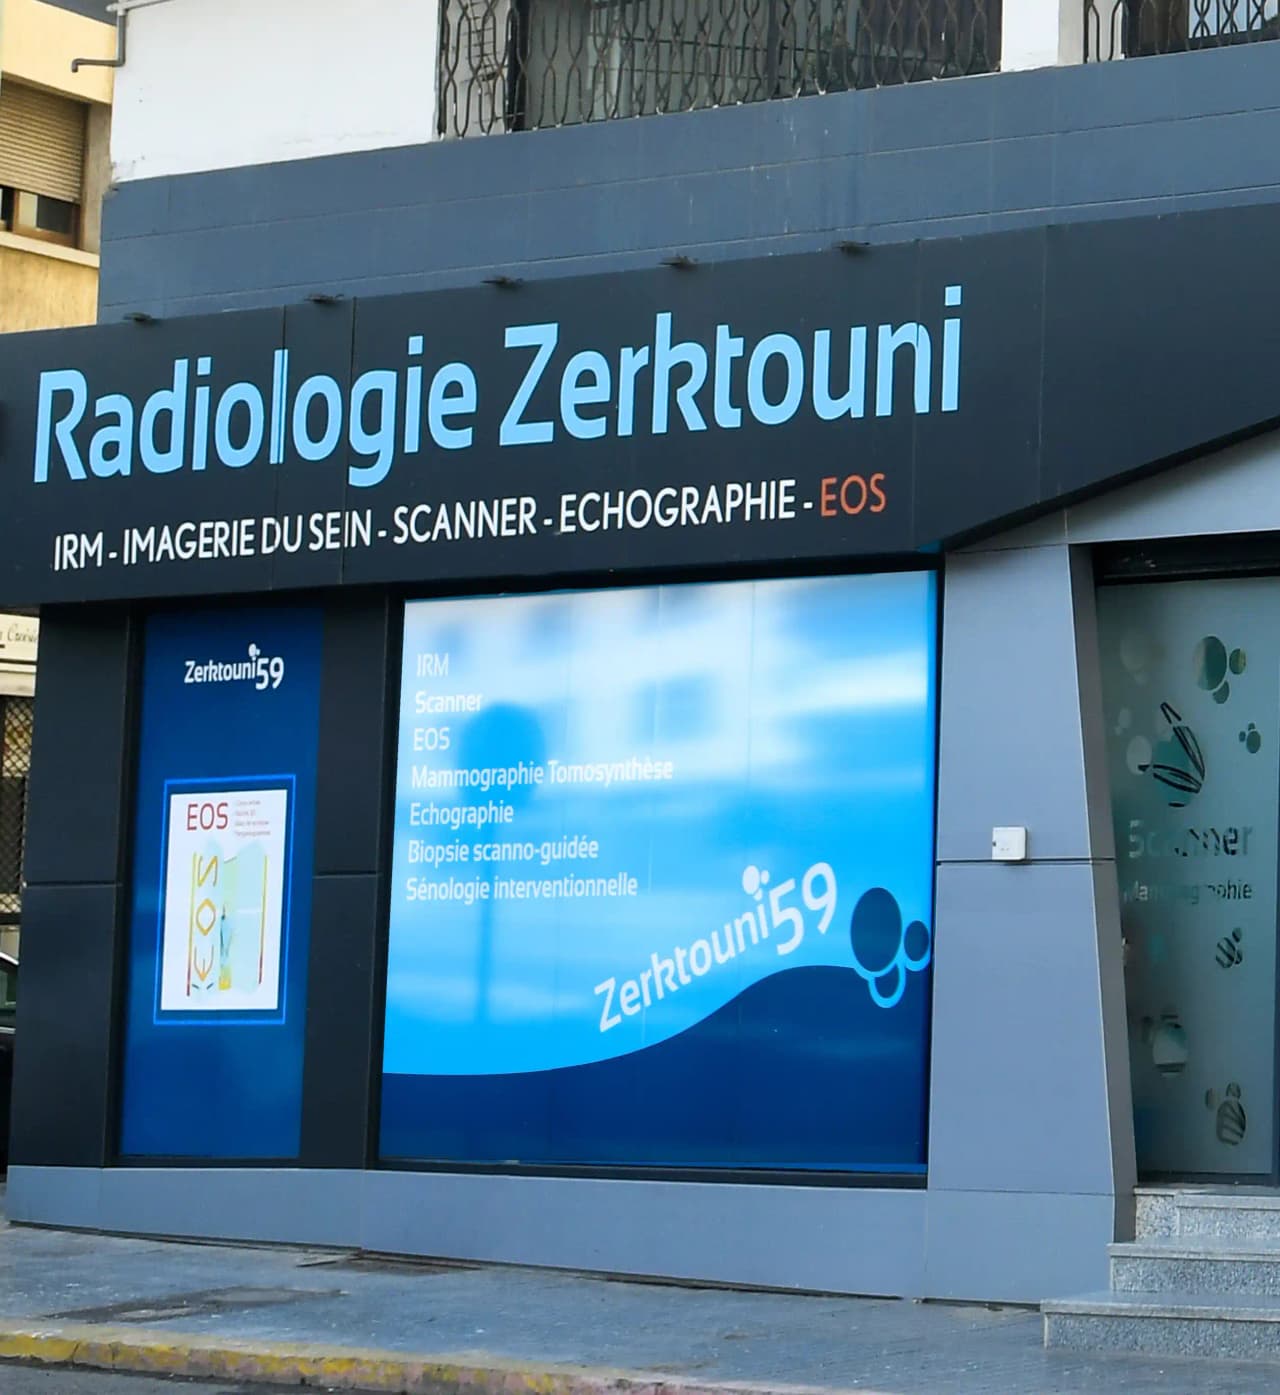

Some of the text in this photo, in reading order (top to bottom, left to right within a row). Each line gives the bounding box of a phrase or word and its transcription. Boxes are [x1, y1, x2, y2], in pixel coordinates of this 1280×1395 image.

[34, 285, 963, 486] Radiologie Zerktouni
[53, 533, 104, 571] IRM
[123, 517, 255, 566] IMAGERIE
[261, 517, 303, 556] DU
[309, 509, 372, 552] SEIN
[392, 496, 537, 546] SCANNER
[560, 478, 796, 533] ECHOGRAPHIE
[819, 473, 888, 518] EOS
[416, 653, 449, 678] IRM
[414, 691, 484, 714] Scanner
[413, 727, 450, 751] EOS
[411, 759, 674, 790] Mammographie Tomosynthèse
[187, 801, 229, 831] EOS
[409, 801, 515, 831] Echographie
[407, 834, 599, 868] Biopsie scanno-guidée
[406, 871, 638, 904] Sénologie interventionnelle
